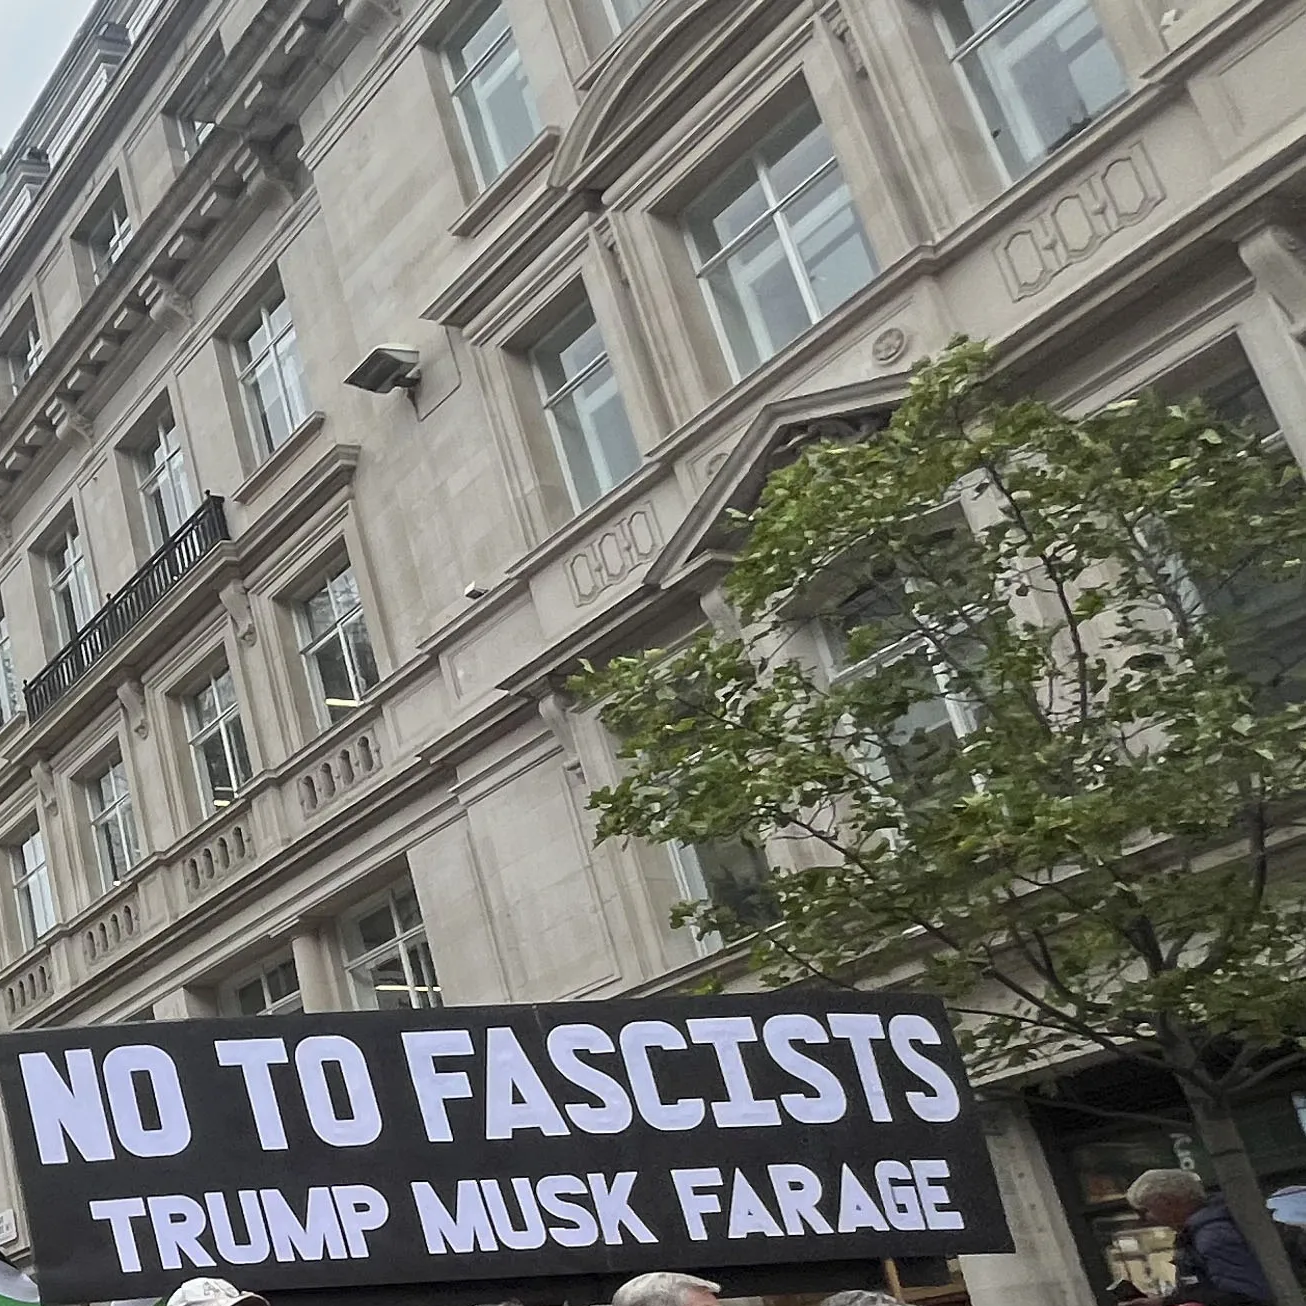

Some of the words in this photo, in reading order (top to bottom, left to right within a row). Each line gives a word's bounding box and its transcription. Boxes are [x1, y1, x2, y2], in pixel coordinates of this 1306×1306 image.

[18, 1044, 192, 1165] NO
[215, 1033, 384, 1152] TO
[400, 1011, 962, 1144] FASCISTS
[90, 1183, 389, 1275] TRUMP
[410, 1170, 663, 1256] MUSK
[670, 1158, 966, 1241] FARAGE
